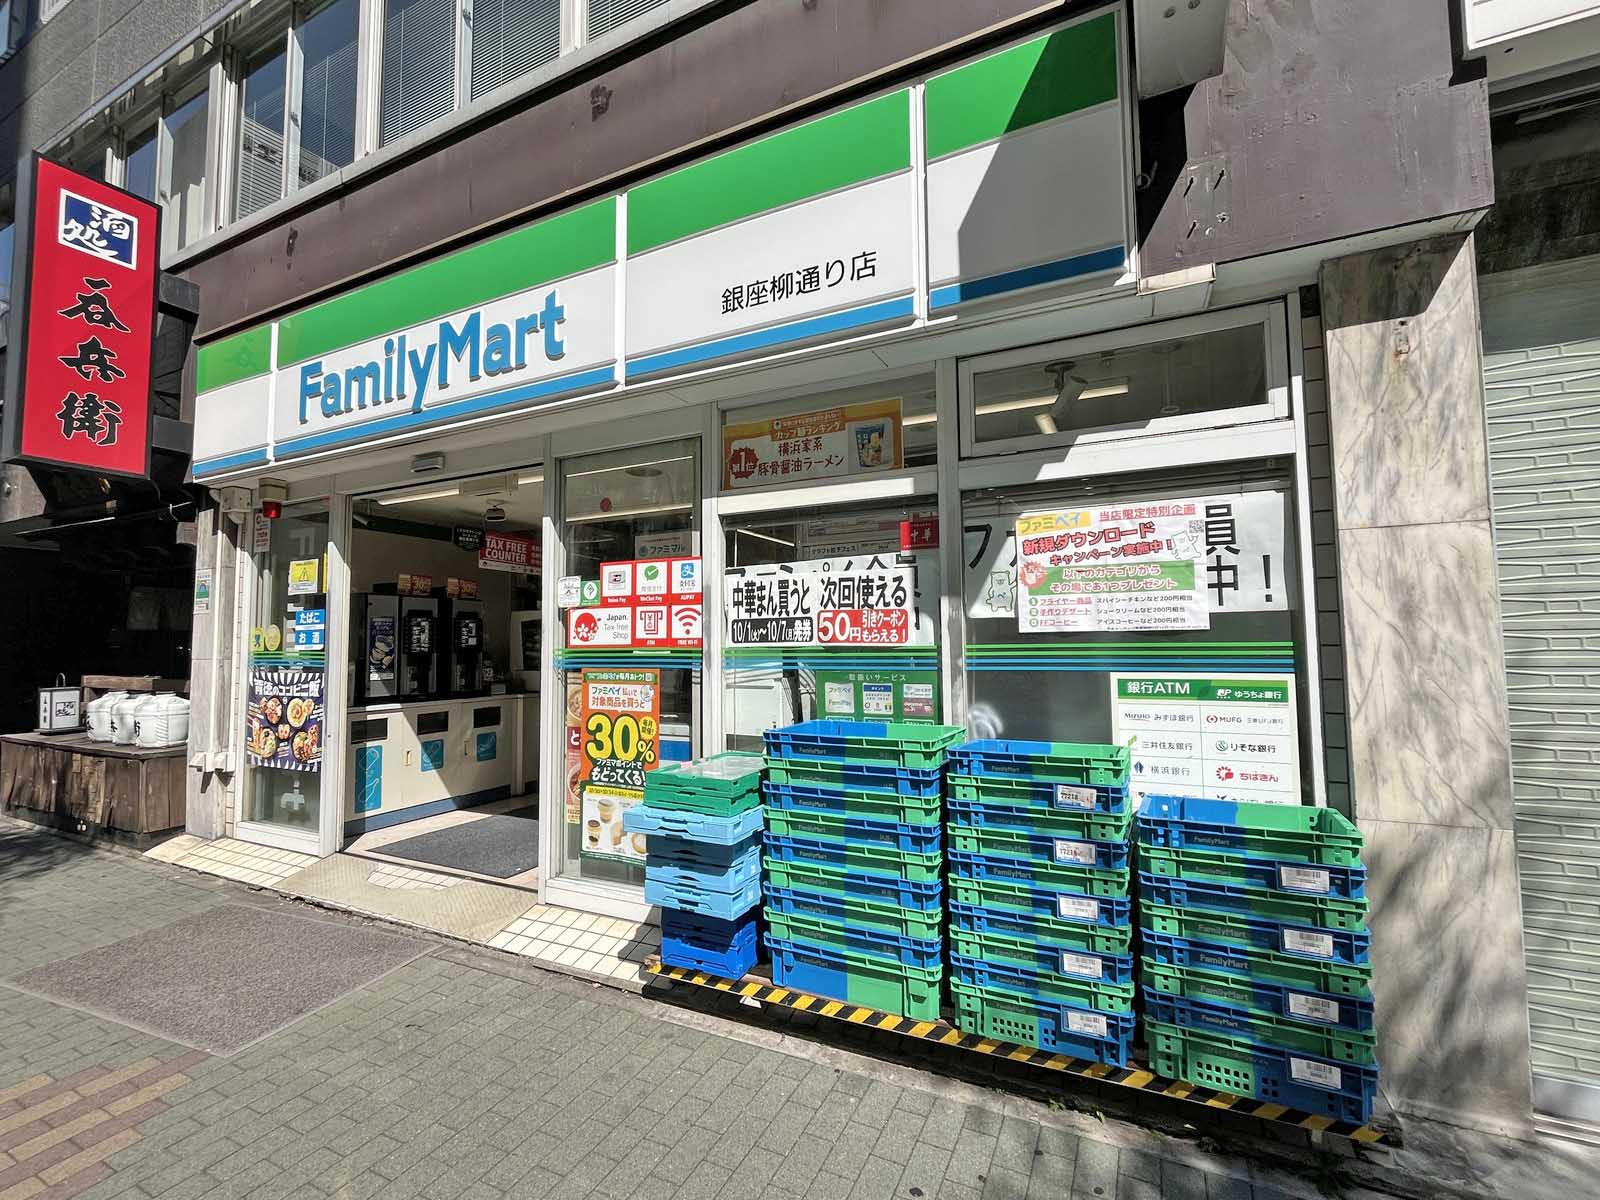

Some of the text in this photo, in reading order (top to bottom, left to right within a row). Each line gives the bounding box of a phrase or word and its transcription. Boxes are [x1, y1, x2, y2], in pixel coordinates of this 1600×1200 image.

[721, 251, 877, 315] 銀座柳通り店
[299, 289, 566, 423] FamilyMart
[779, 436, 823, 456] 横浜家系
[758, 454, 845, 476] 豚骨醤油ラーメン
[1099, 503, 1196, 522] 当店限定特別企画
[1019, 511, 1081, 532] ファミペイ
[486, 538, 527, 554] TAX FREE
[1022, 521, 1156, 556] 新規ダウンロード
[485, 548, 527, 563] COUNTER
[1063, 564, 1161, 579] 以下のカテゴリから
[732, 575, 906, 619] 中華まん買うと 次回使える
[299, 611, 320, 624] たばこ
[863, 608, 905, 628] 引きクーポン
[819, 611, 861, 641] 50円
[612, 631, 628, 640] Shop
[253, 678, 321, 697] 背徳のコンビニ飯
[1127, 681, 1190, 694] 銀行ATM
[1234, 691, 1282, 699] ゆうちょ銀行
[592, 695, 646, 709] 対象商品を買うと
[1153, 713, 1194, 723] みずほ銀行
[1219, 716, 1243, 724] MUFG
[586, 713, 655, 763] 30%
[1142, 740, 1193, 751] 三井住友銀行
[1231, 743, 1277, 754] りそな銀行
[597, 759, 642, 769] ファミマポイントで
[1151, 766, 1191, 776] 横浜銀行
[993, 867, 1032, 880] FamilyMart
[1200, 953, 1249, 969] FamilyMart
[1201, 1014, 1239, 1028] FamilyMart
